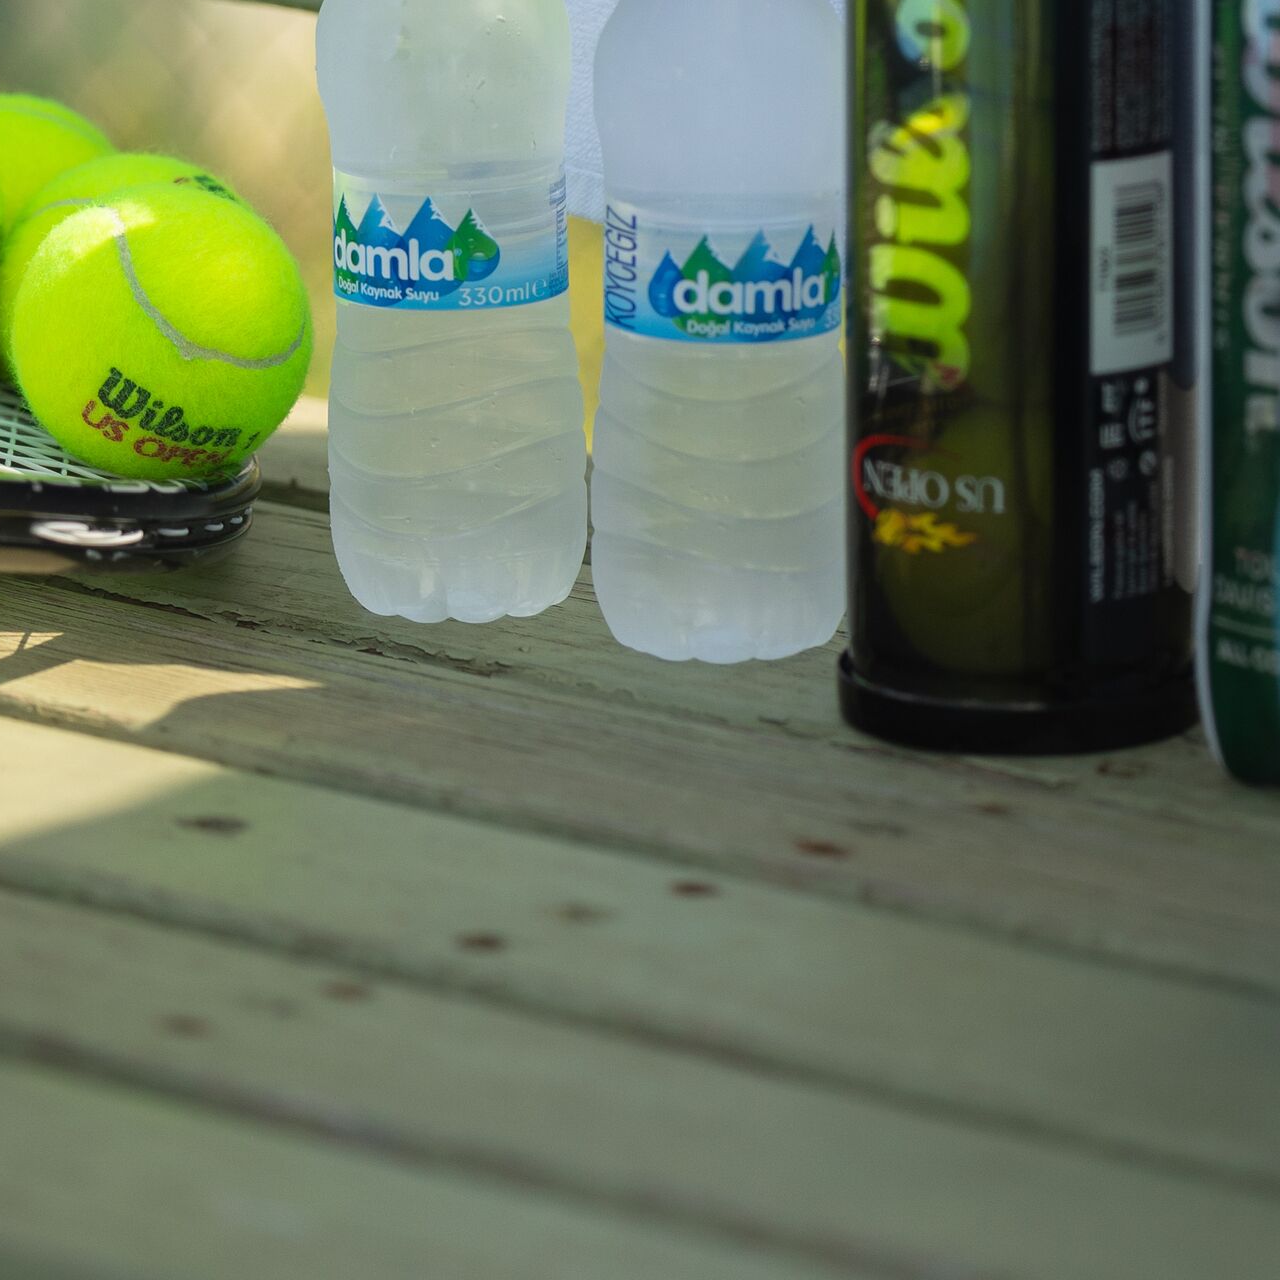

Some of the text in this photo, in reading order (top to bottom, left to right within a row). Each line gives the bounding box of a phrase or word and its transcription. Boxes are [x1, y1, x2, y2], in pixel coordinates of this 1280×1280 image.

[334, 228, 454, 281] damla
[338, 276, 439, 304] Doğal Kaynak Suyu
[673, 267, 825, 315] damla
[687, 319, 730, 337] Doğal
[734, 318, 785, 336] Kaynak
[788, 317, 815, 334] Suyu
[82, 400, 130, 442] US
[98, 367, 242, 446] Wilson
[863, 456, 1006, 513] US OPEN
